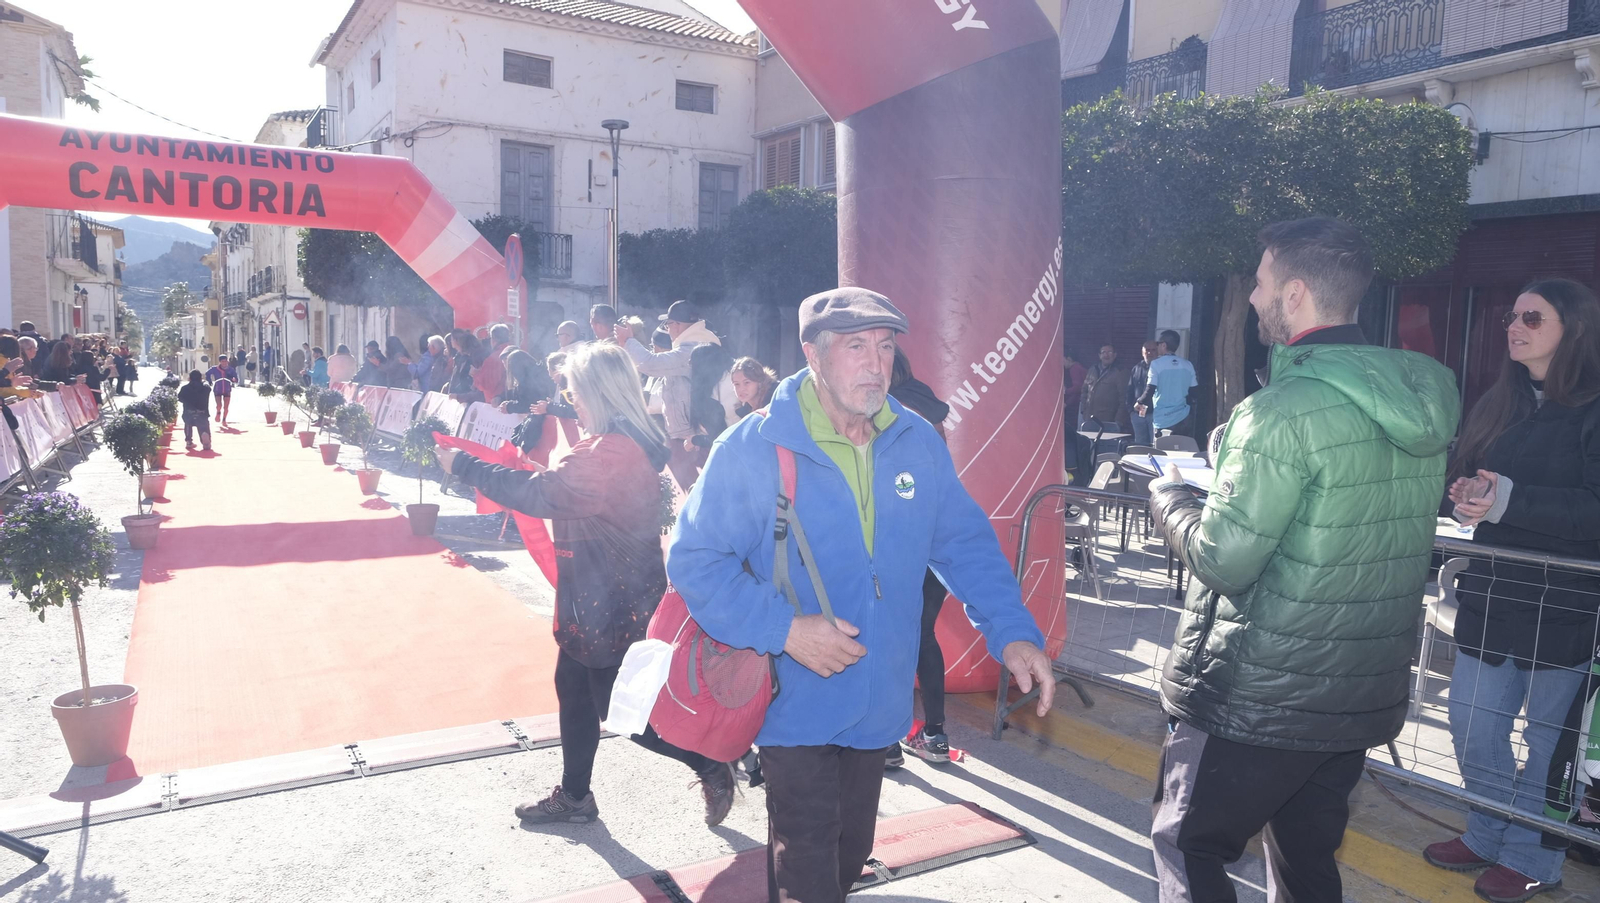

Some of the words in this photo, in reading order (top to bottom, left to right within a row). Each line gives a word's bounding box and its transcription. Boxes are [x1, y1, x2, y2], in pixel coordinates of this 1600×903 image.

[59, 128, 335, 173] AYUNTAMIENTO
[68, 161, 326, 217] CANTORIA
[942, 236, 1063, 431] ww.teamergy.es
[477, 418, 514, 437] AYUNTAMIENT
